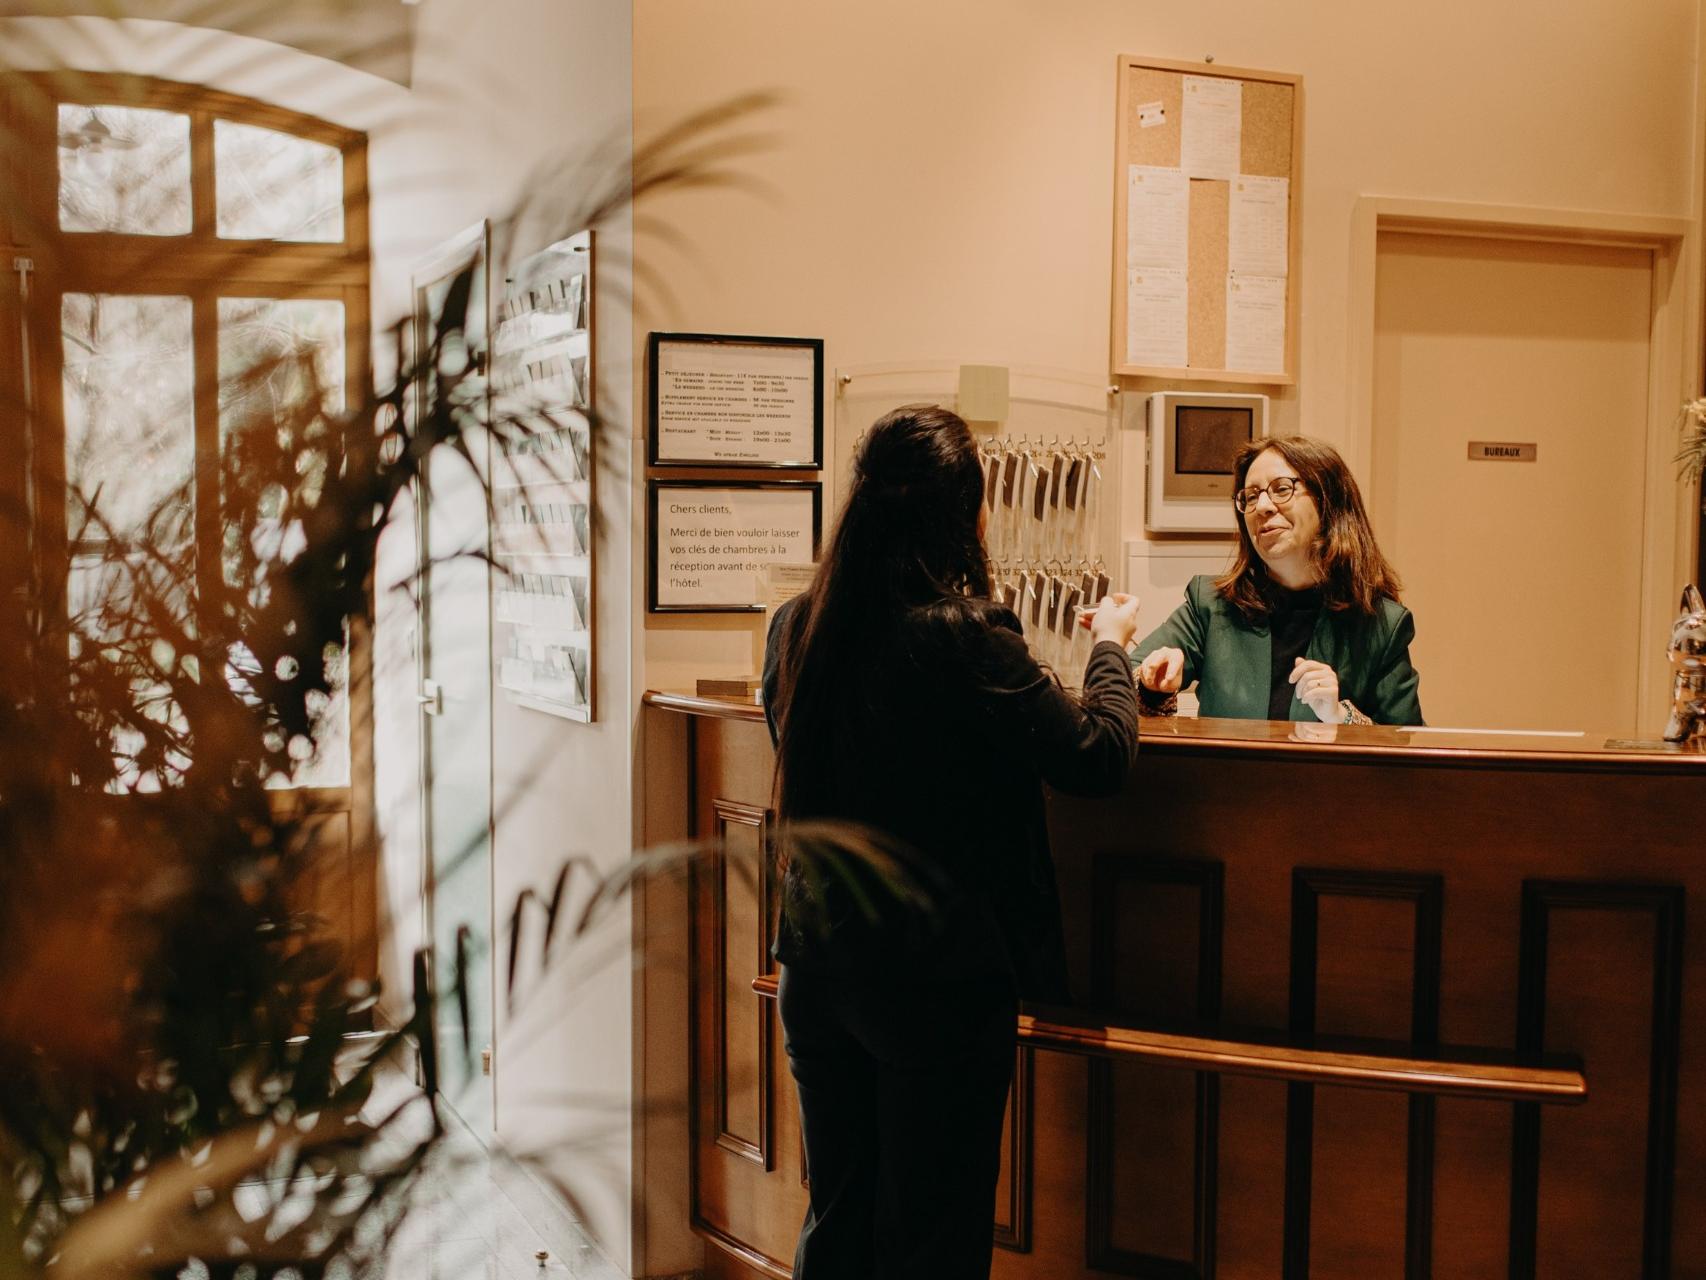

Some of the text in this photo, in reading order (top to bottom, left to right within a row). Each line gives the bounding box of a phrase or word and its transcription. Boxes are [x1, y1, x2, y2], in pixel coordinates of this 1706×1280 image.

[1484, 447, 1520, 456] BUREAUX
[670, 504, 732, 514] Chers clients,
[670, 528, 800, 537] Merci de bien vouloir laisser
[688, 545, 706, 554] clés
[709, 545, 720, 554] de
[723, 545, 768, 554] chambres
[771, 545, 776, 554] à
[778, 545, 786, 554] la
[670, 562, 715, 572] réception
[746, 562, 757, 571] de
